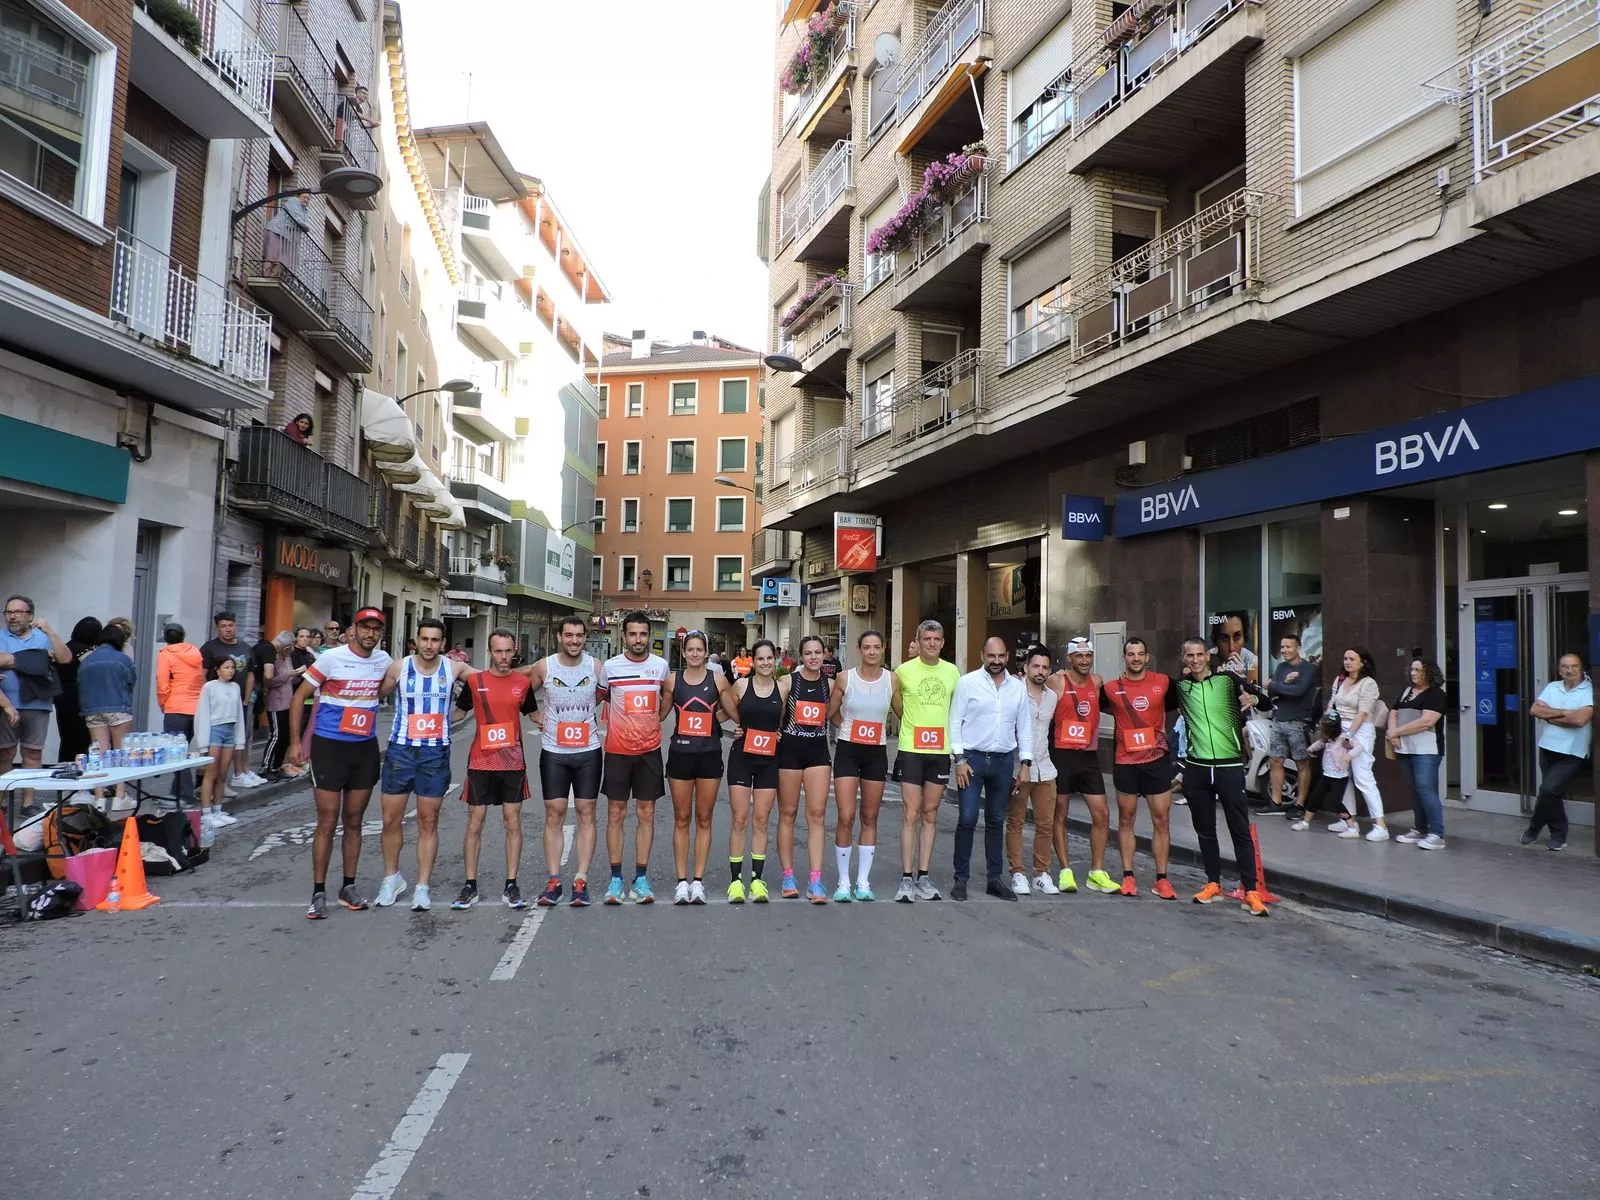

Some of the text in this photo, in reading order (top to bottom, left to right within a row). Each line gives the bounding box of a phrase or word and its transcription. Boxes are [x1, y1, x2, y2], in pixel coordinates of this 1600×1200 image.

[1374, 418, 1479, 475] BBVA
[1140, 484, 1200, 522] BBVA
[840, 516, 852, 524] BAR
[1068, 512, 1100, 524] BBVA
[280, 540, 318, 572] MODA
[990, 601, 1012, 616] Elena
[1273, 609, 1296, 620] BBVA
[1209, 615, 1228, 625] BBVA
[633, 695, 649, 707] 01
[802, 706, 820, 719] 09
[351, 713, 367, 727] 10
[416, 718, 436, 731] 04
[688, 717, 702, 729] 12
[488, 728, 506, 741] 08
[564, 726, 582, 740] 03
[858, 725, 875, 738] 06
[921, 731, 938, 743] 05
[1068, 726, 1085, 737] 02
[753, 735, 770, 748] 07
[1133, 733, 1145, 744] 11
